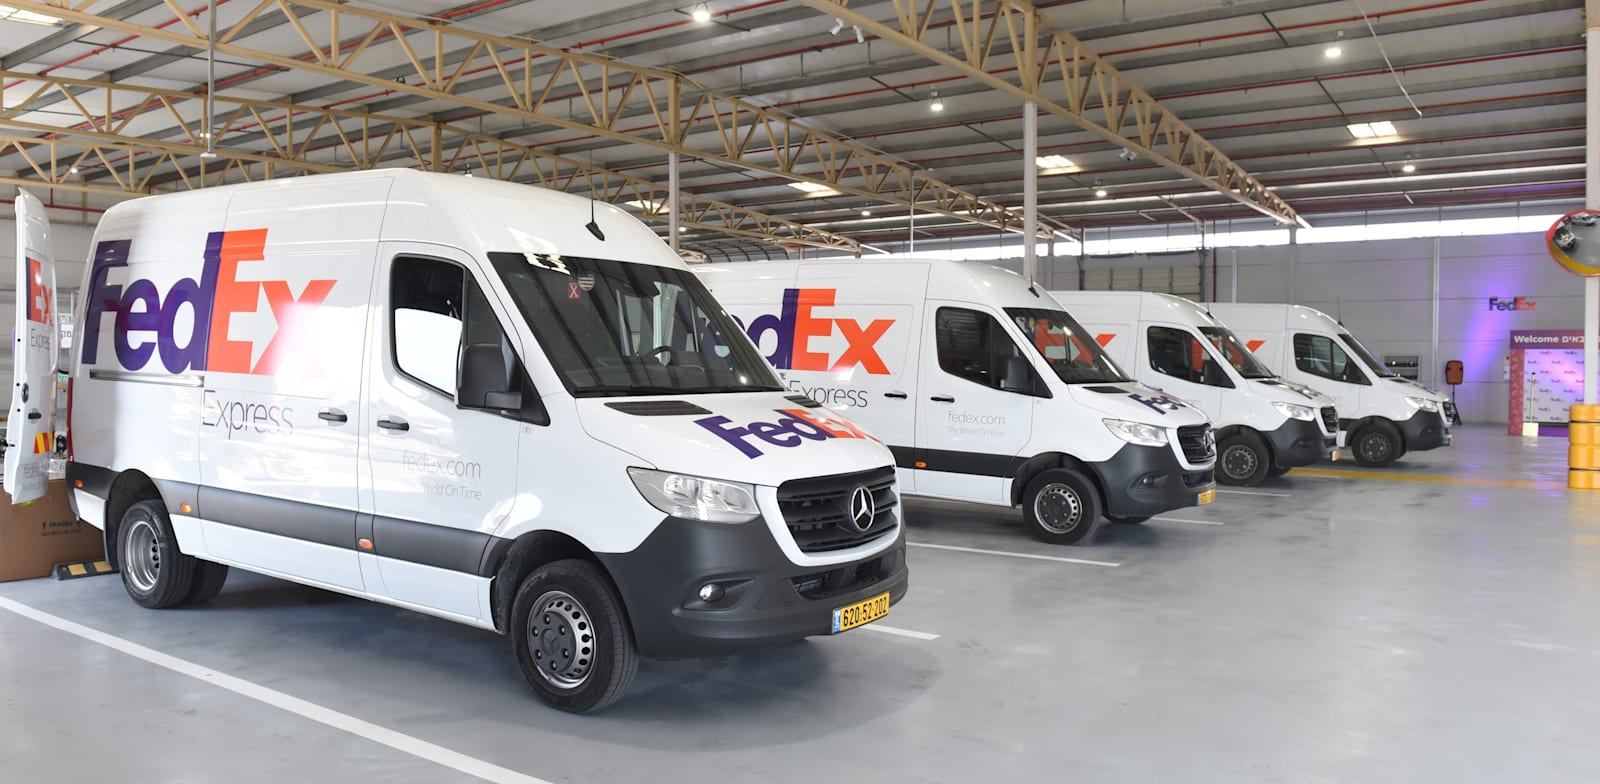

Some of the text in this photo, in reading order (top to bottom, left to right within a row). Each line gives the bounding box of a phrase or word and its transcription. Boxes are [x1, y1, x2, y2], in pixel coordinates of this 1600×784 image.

[26, 256, 54, 327] Ex
[82, 228, 337, 375] FedEx
[1488, 296, 1537, 311] FedEx
[1514, 335, 1559, 343] Welcome
[201, 389, 294, 439] Express
[948, 410, 1006, 425] fedex.com
[402, 449, 481, 479] fedex.com
[445, 484, 459, 497] On
[461, 486, 481, 501] Time
